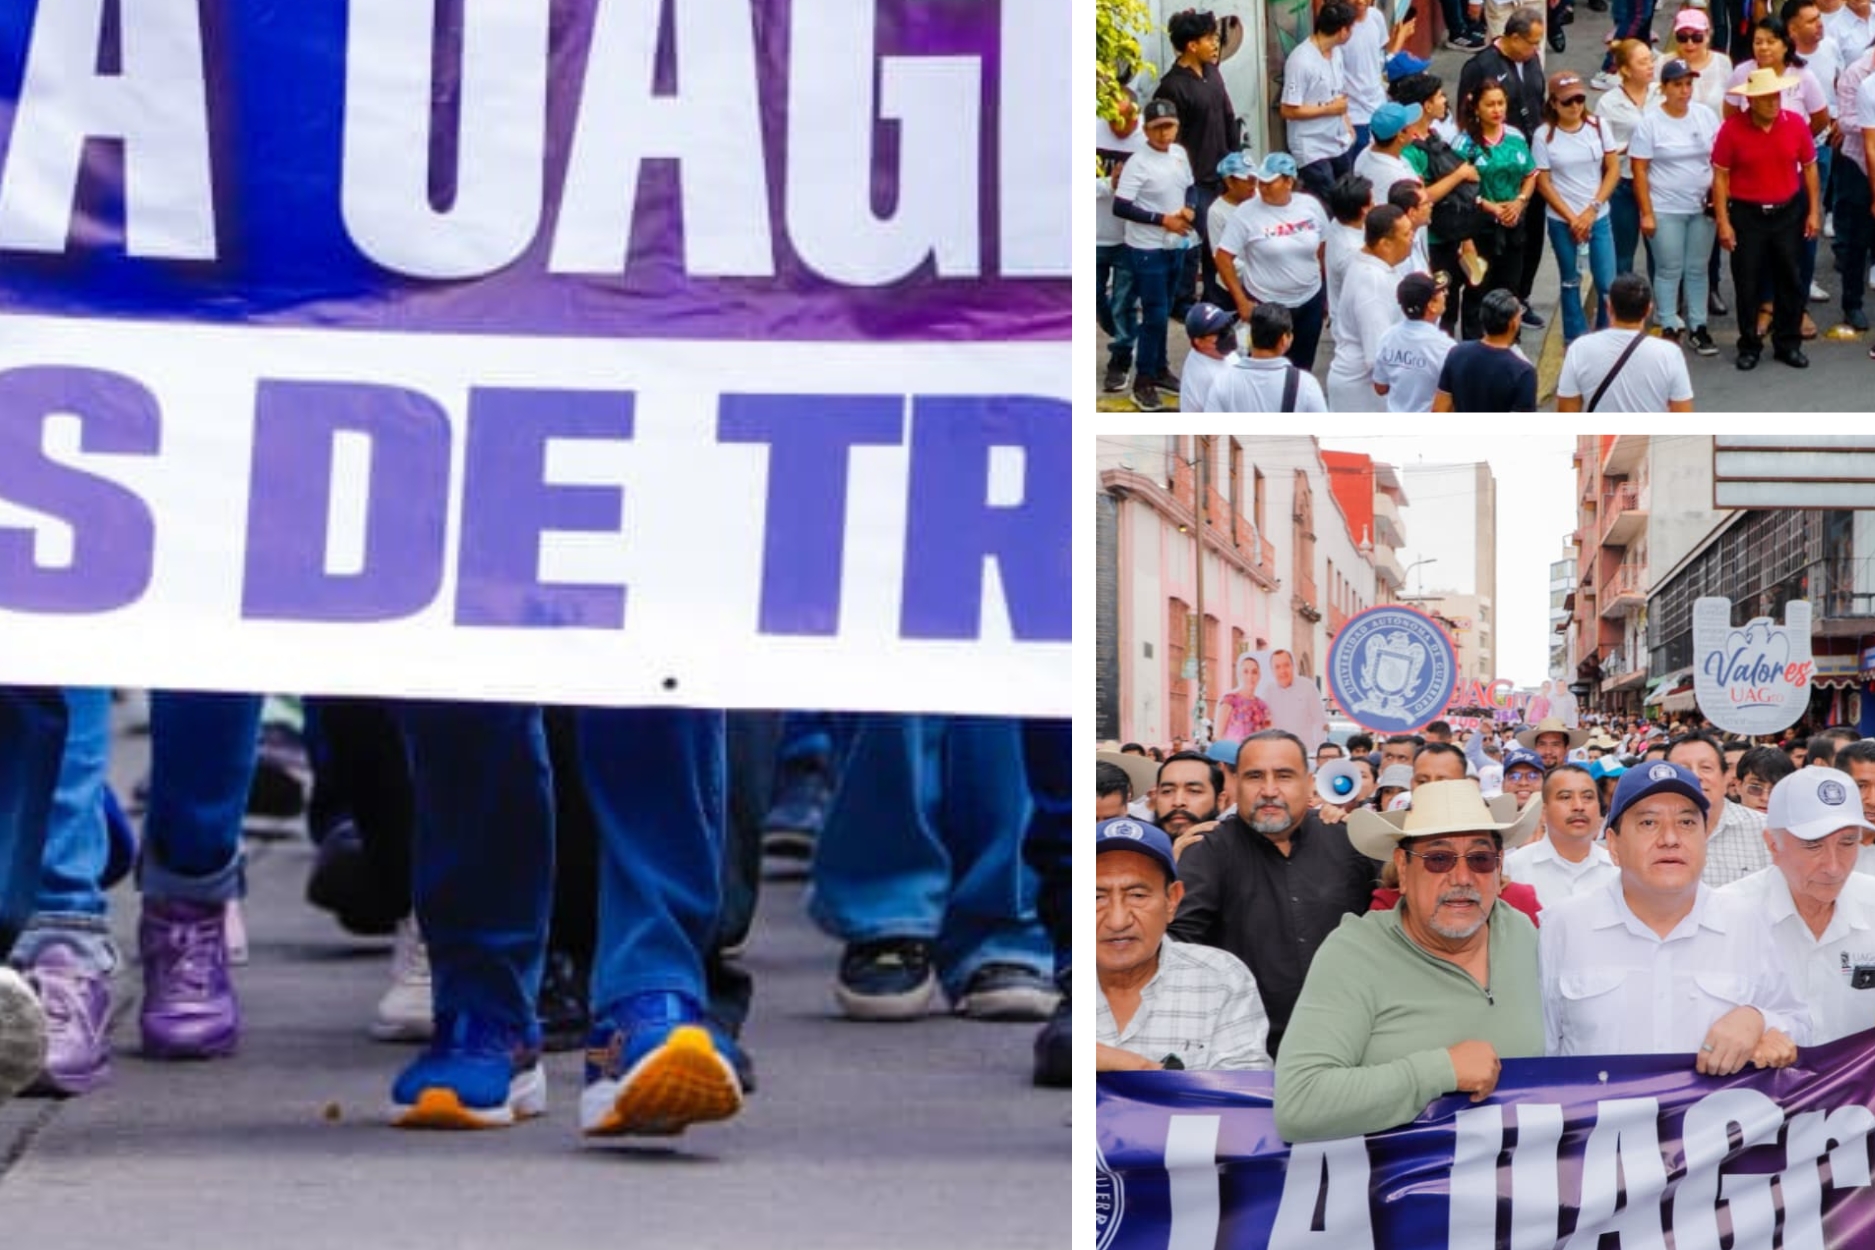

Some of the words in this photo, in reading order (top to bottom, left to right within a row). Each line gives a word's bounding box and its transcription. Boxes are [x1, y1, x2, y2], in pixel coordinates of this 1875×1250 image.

[240, 377, 636, 630] DE
[1340, 626, 1368, 695] UNIVERSIDAD
[1704, 646, 1813, 687] Valores
[1730, 686, 1784, 702] UAGro
